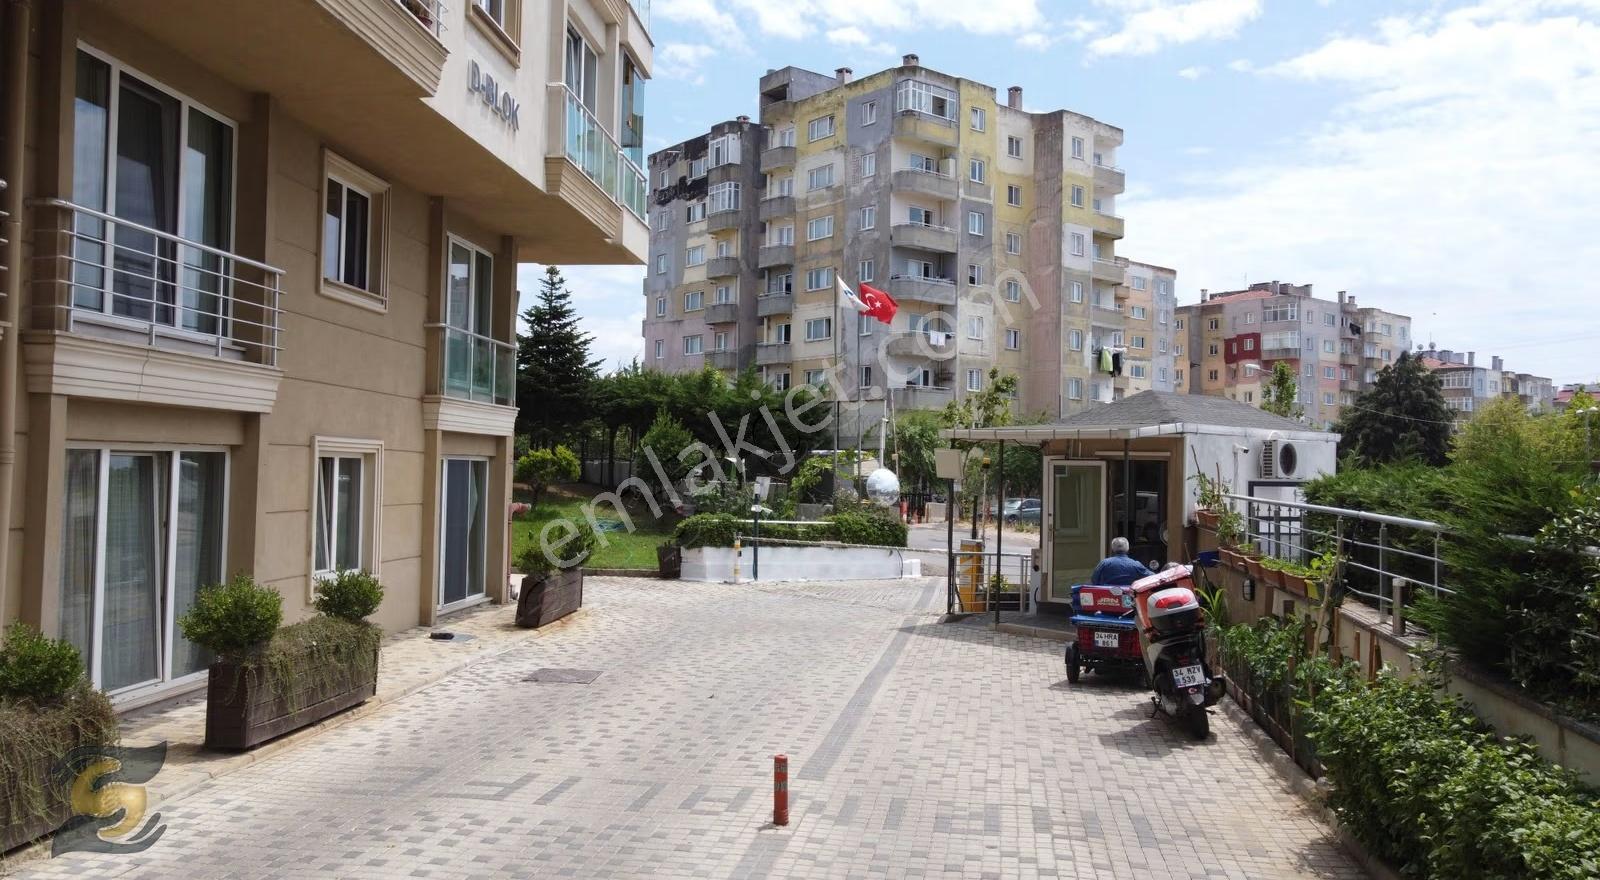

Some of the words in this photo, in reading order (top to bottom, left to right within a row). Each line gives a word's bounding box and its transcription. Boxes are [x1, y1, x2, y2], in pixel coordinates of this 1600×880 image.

[467, 59, 520, 132] D-BLOK
[1174, 669, 1184, 677] 34
[1182, 675, 1196, 683] 539
